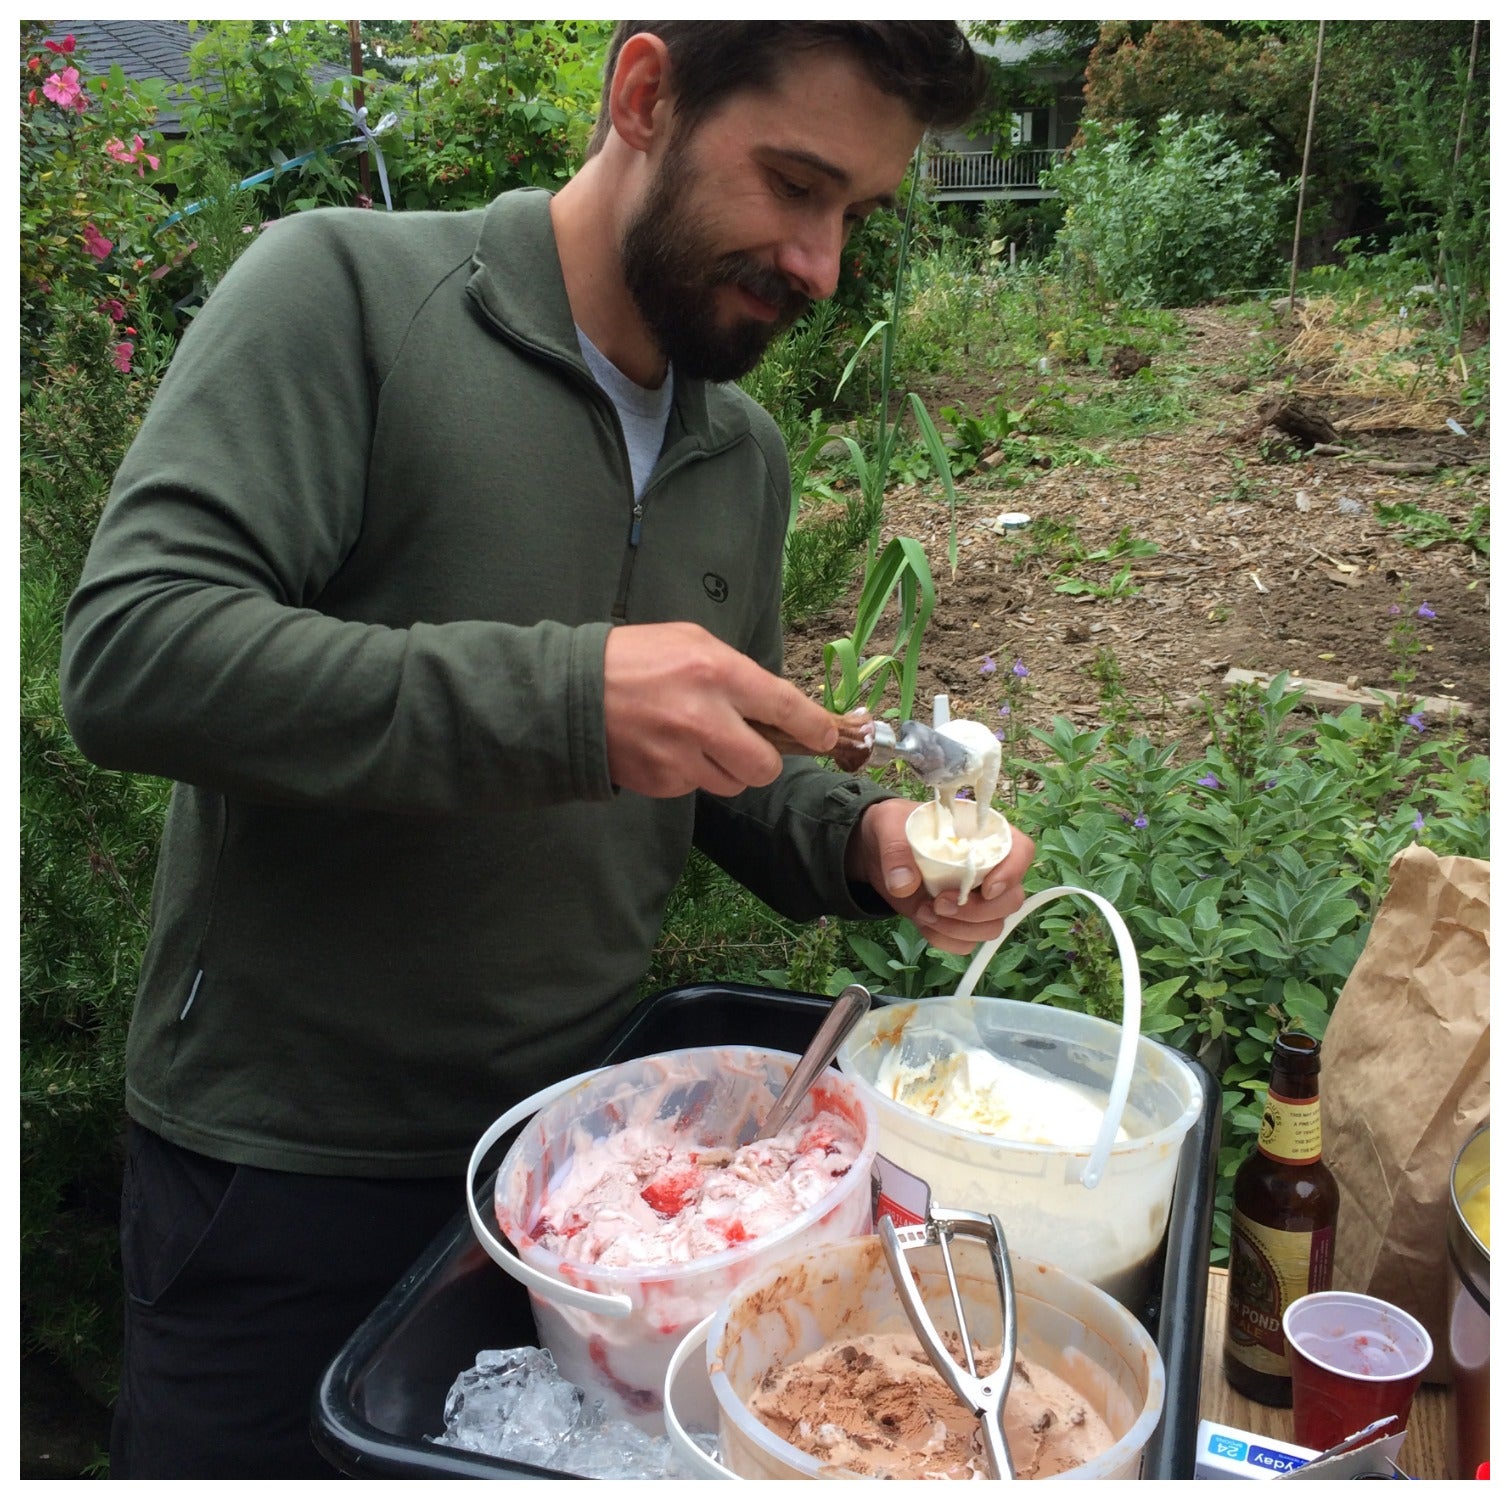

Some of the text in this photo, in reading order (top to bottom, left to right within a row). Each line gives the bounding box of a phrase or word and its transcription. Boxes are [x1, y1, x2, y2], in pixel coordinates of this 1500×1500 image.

[1241, 1304, 1280, 1332] POND
[1217, 1443, 1239, 1457] 24
[1254, 1454, 1297, 1475] yday
